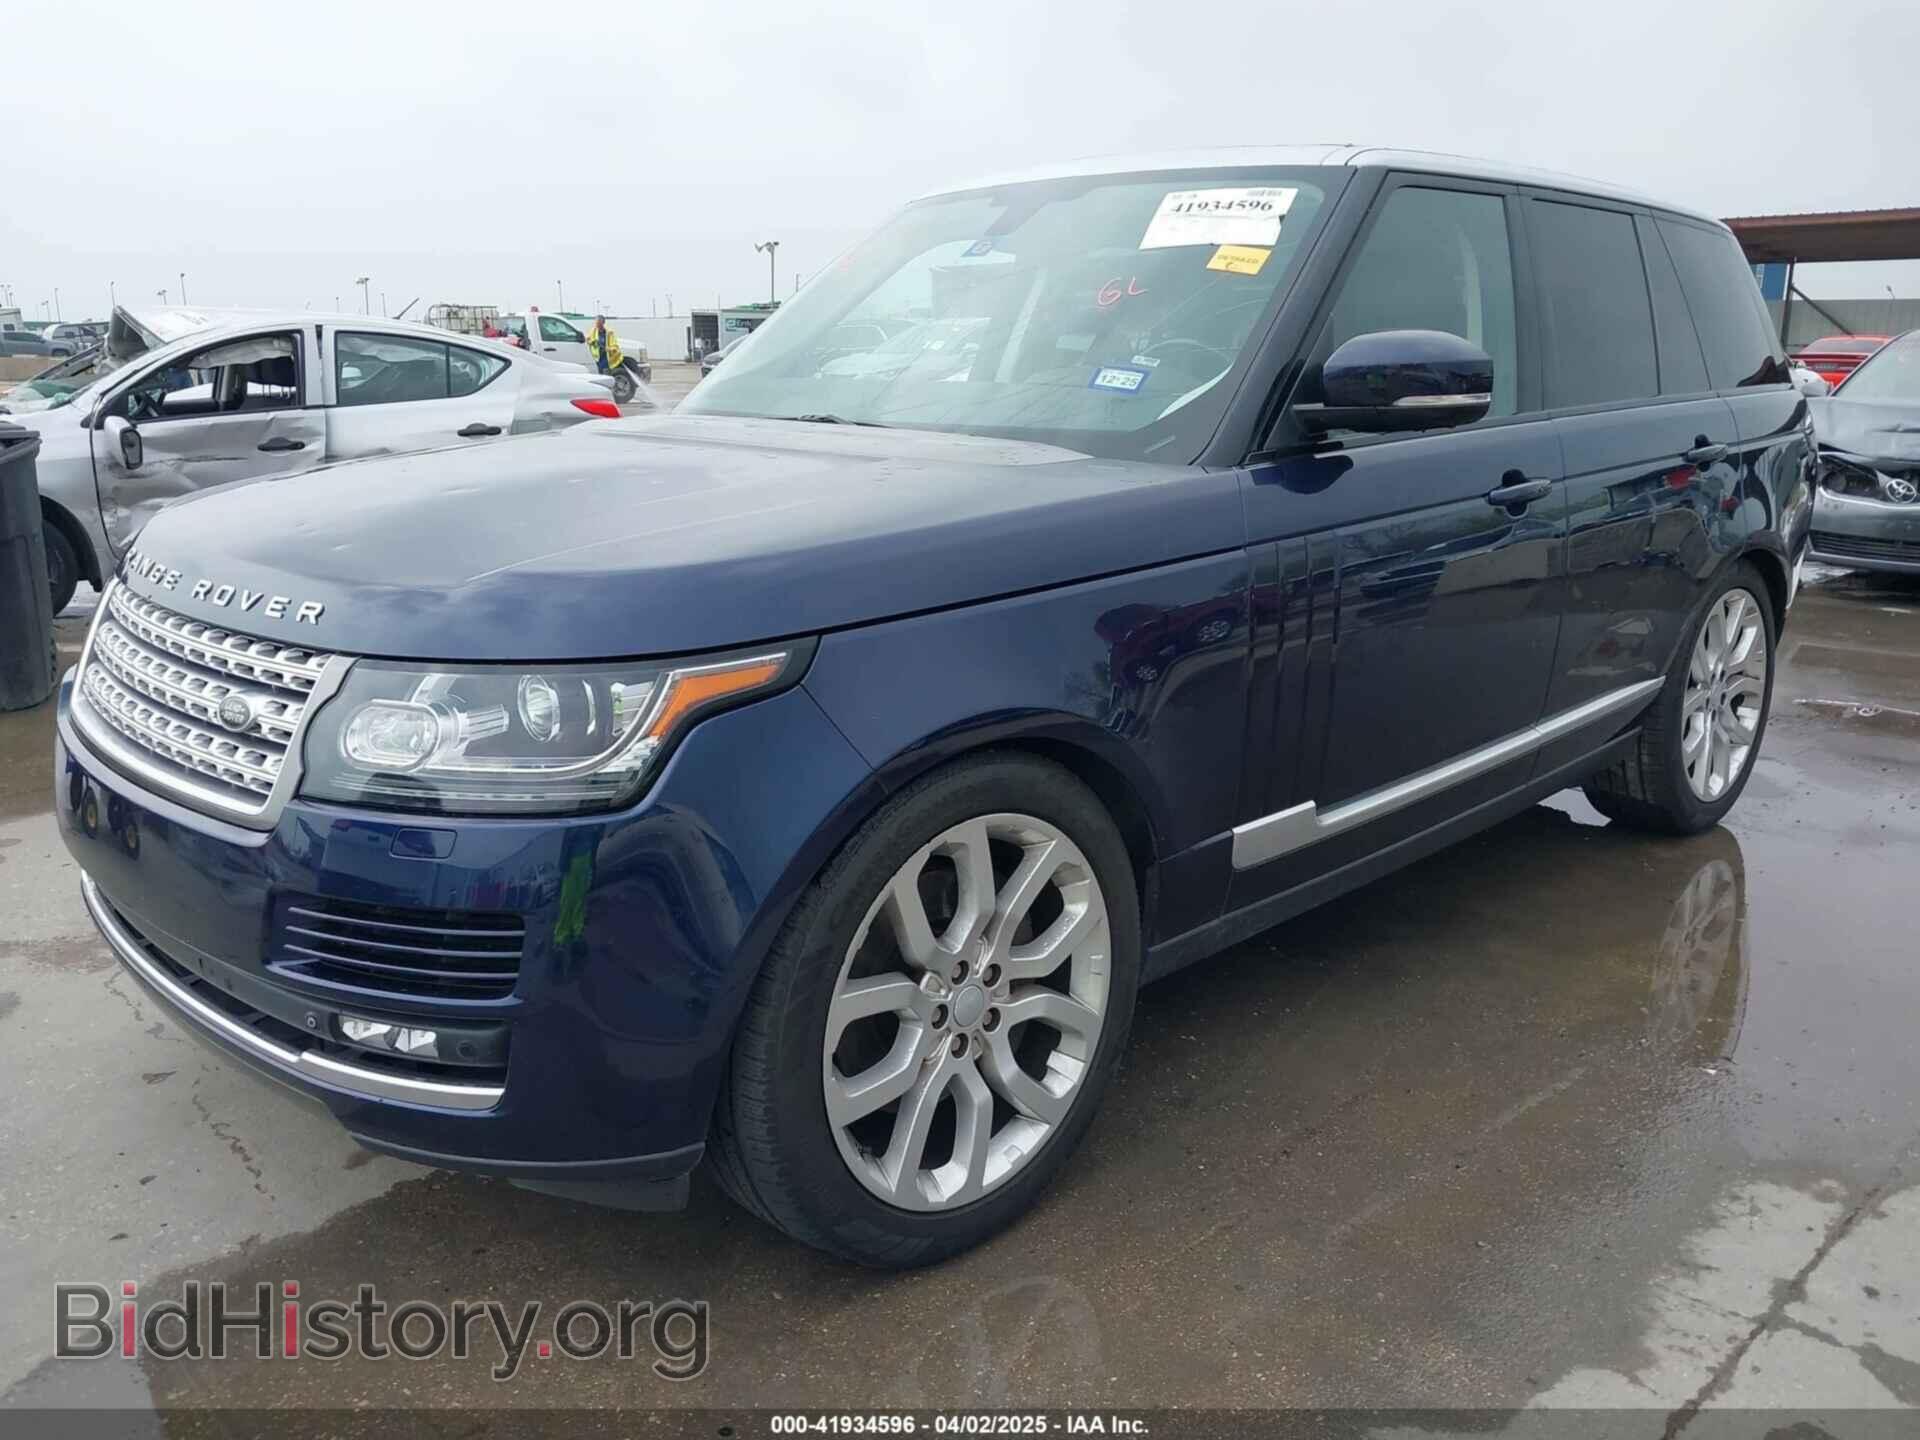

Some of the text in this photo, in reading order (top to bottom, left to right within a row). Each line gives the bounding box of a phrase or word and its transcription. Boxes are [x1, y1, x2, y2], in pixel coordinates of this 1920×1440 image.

[1170, 200, 1273, 213] 41934596
[125, 547, 325, 625] RANGE ROVER
